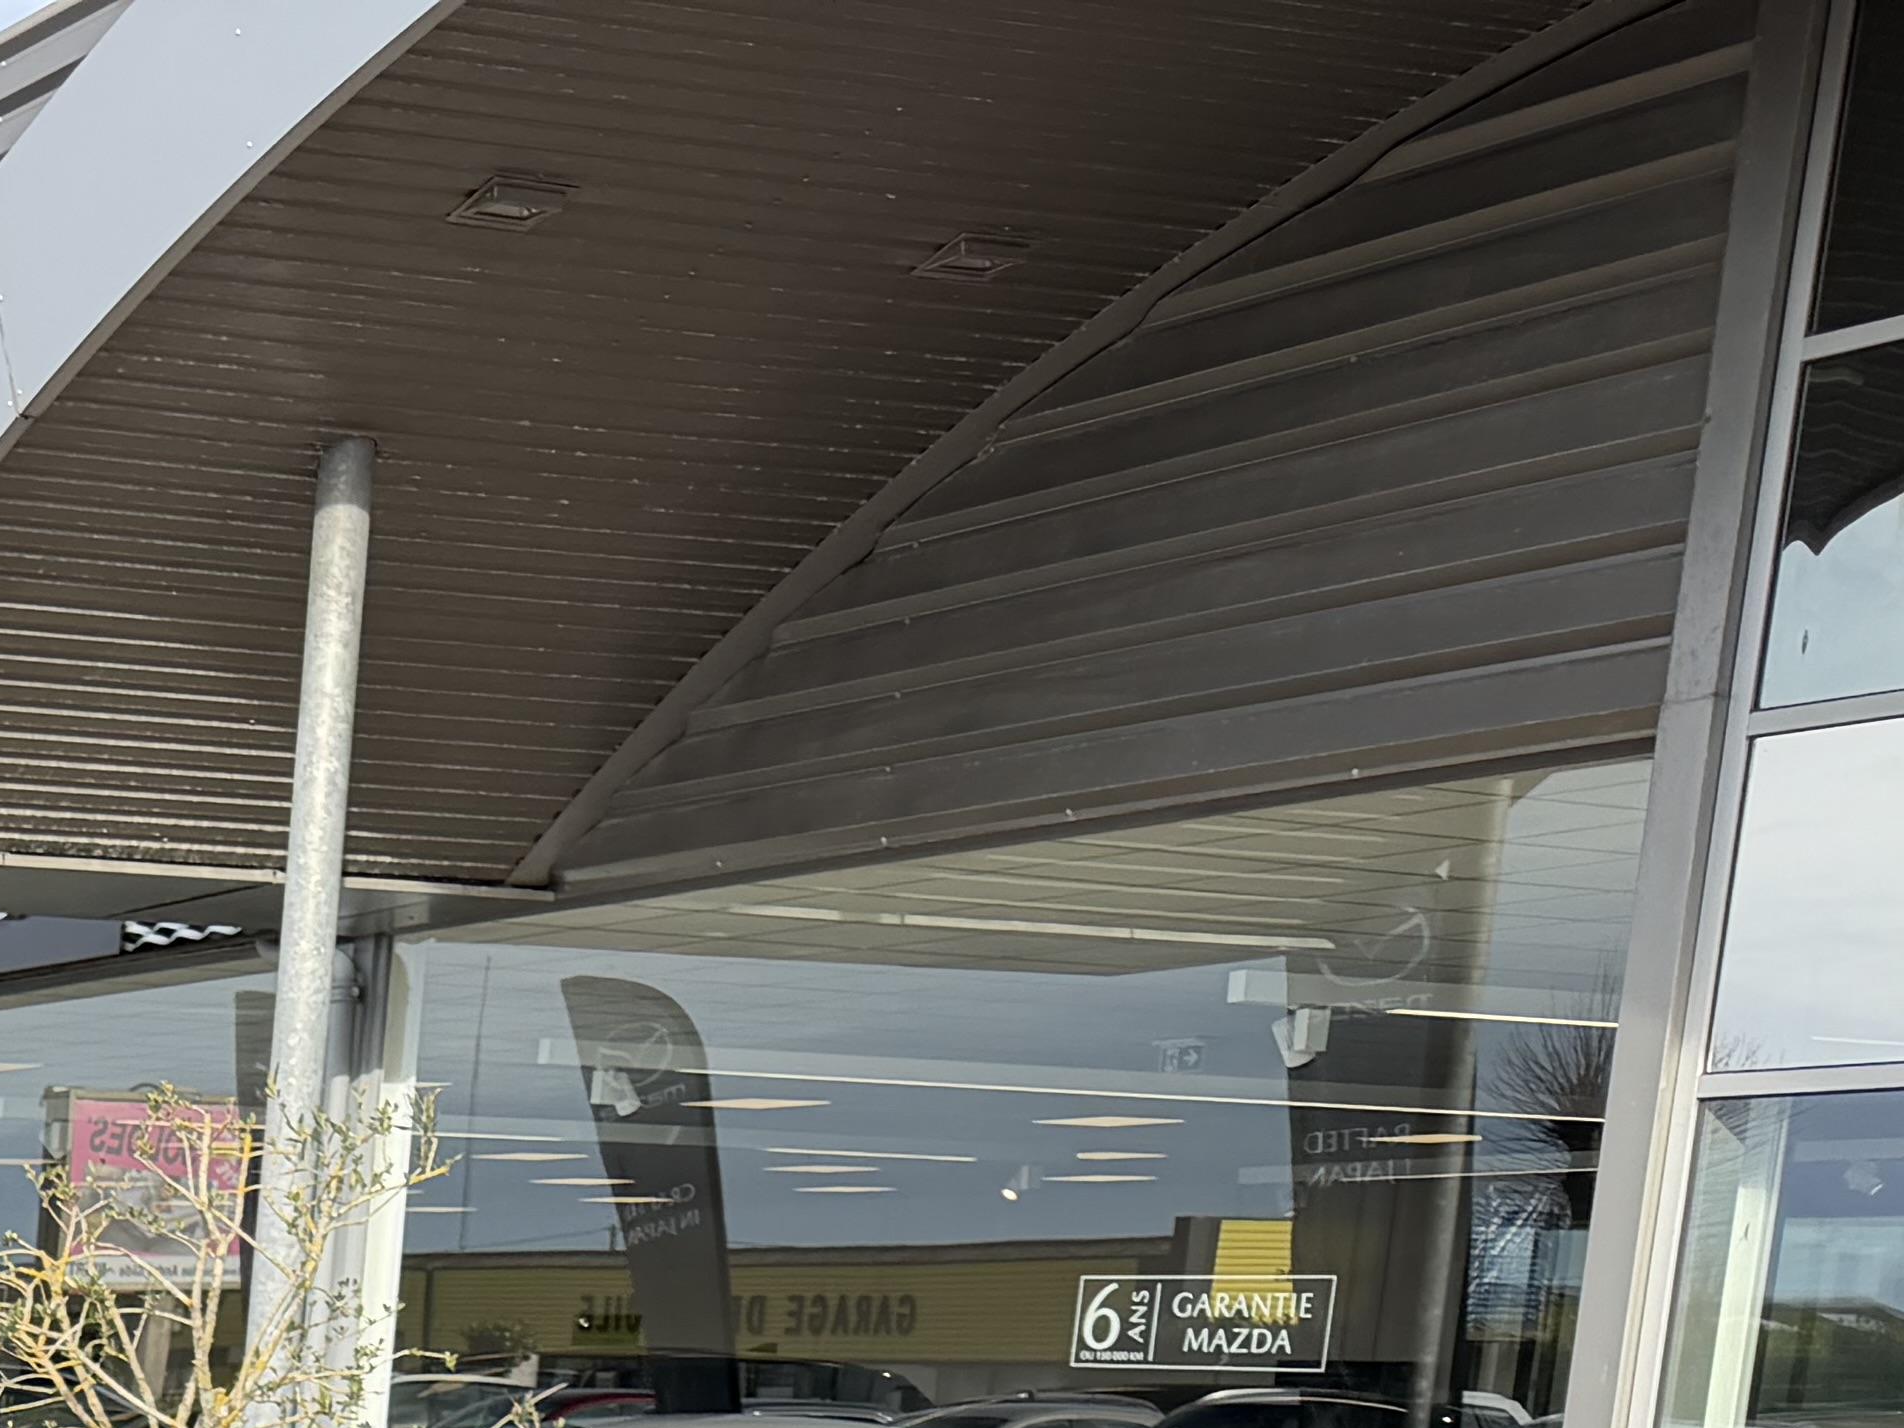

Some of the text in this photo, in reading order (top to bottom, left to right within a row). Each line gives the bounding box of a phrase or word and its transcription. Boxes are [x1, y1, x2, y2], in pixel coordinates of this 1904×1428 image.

[1083, 1282, 1150, 1350] 6 ANS
[1171, 1291, 1314, 1320] GARANTIE
[1182, 1327, 1292, 1355] MAZDA
